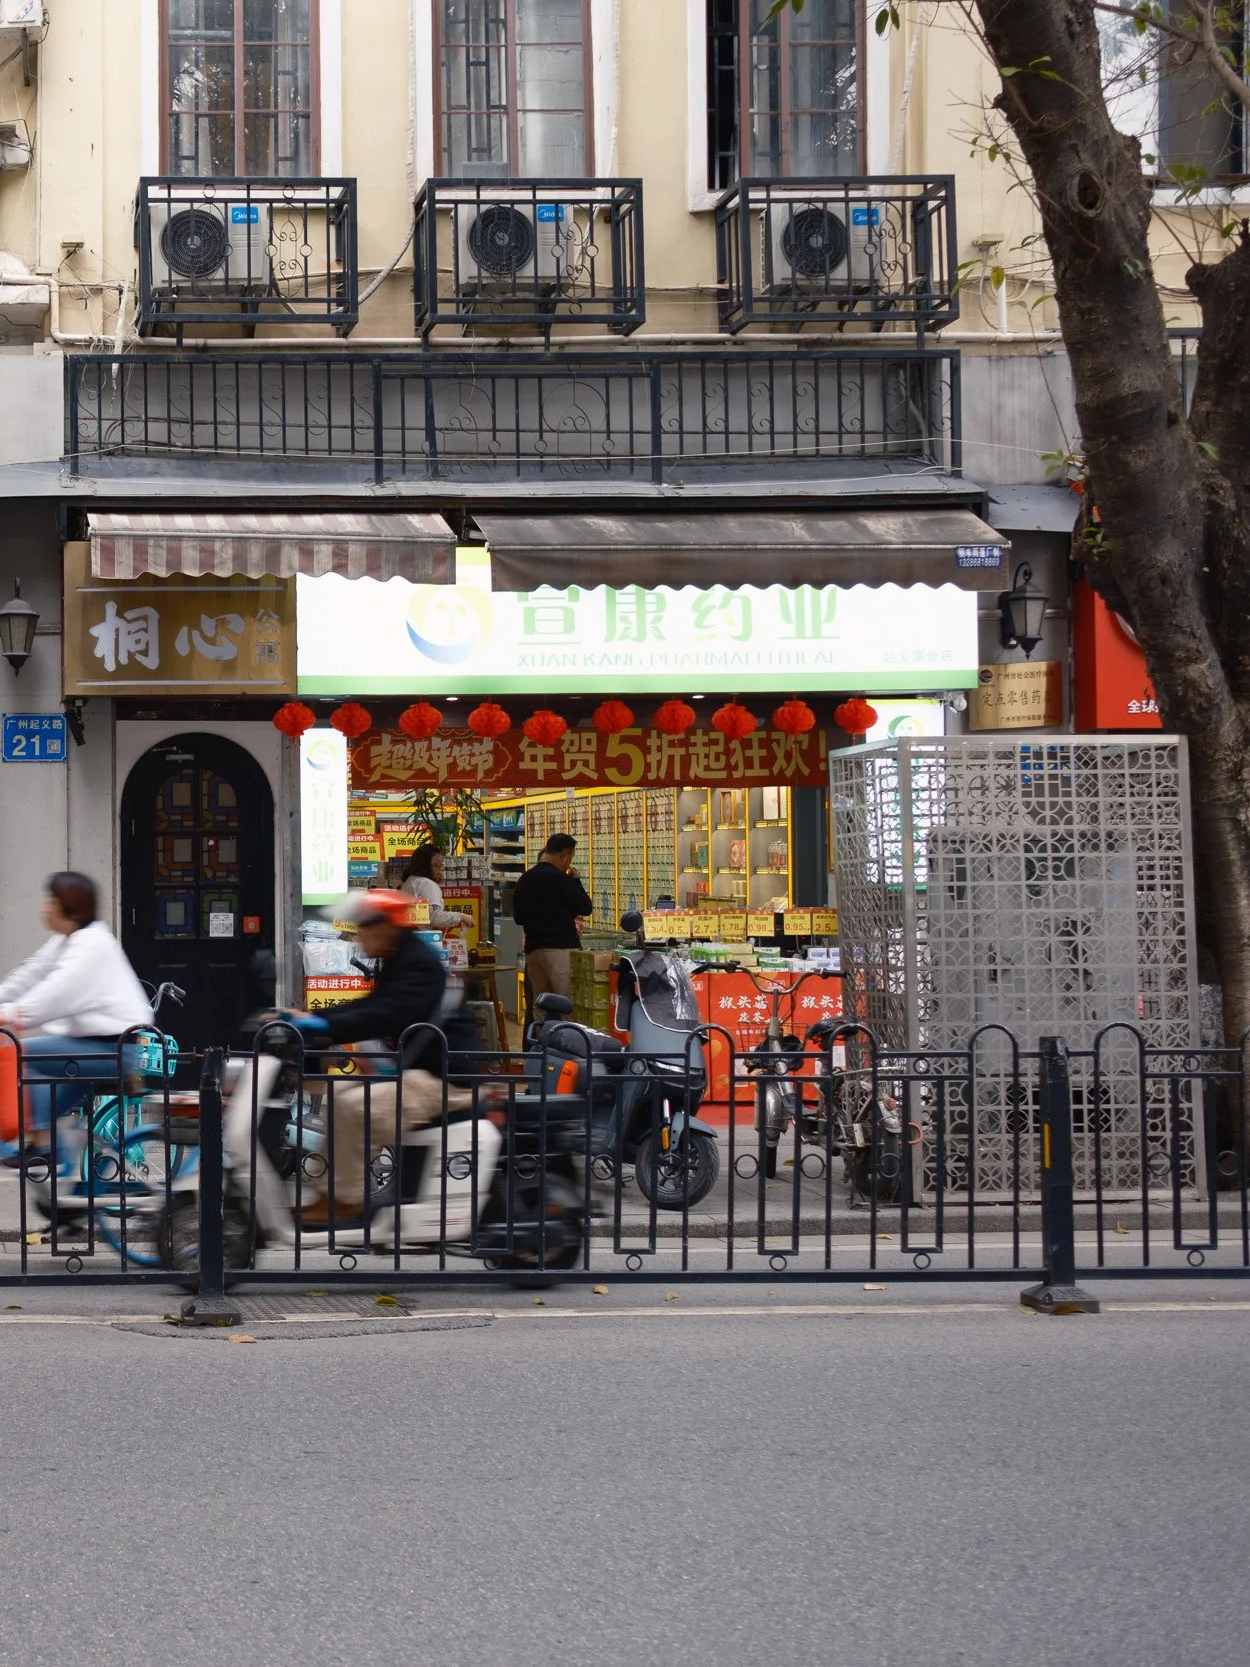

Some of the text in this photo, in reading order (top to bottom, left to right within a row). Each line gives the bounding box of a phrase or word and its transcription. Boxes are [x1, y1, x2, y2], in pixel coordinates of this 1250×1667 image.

[89, 600, 246, 672] 桐心
[254, 607, 280, 667] 公寓
[6, 719, 63, 735] 广州起义路
[12, 735, 40, 756] 21
[368, 732, 495, 783] 超级年货节
